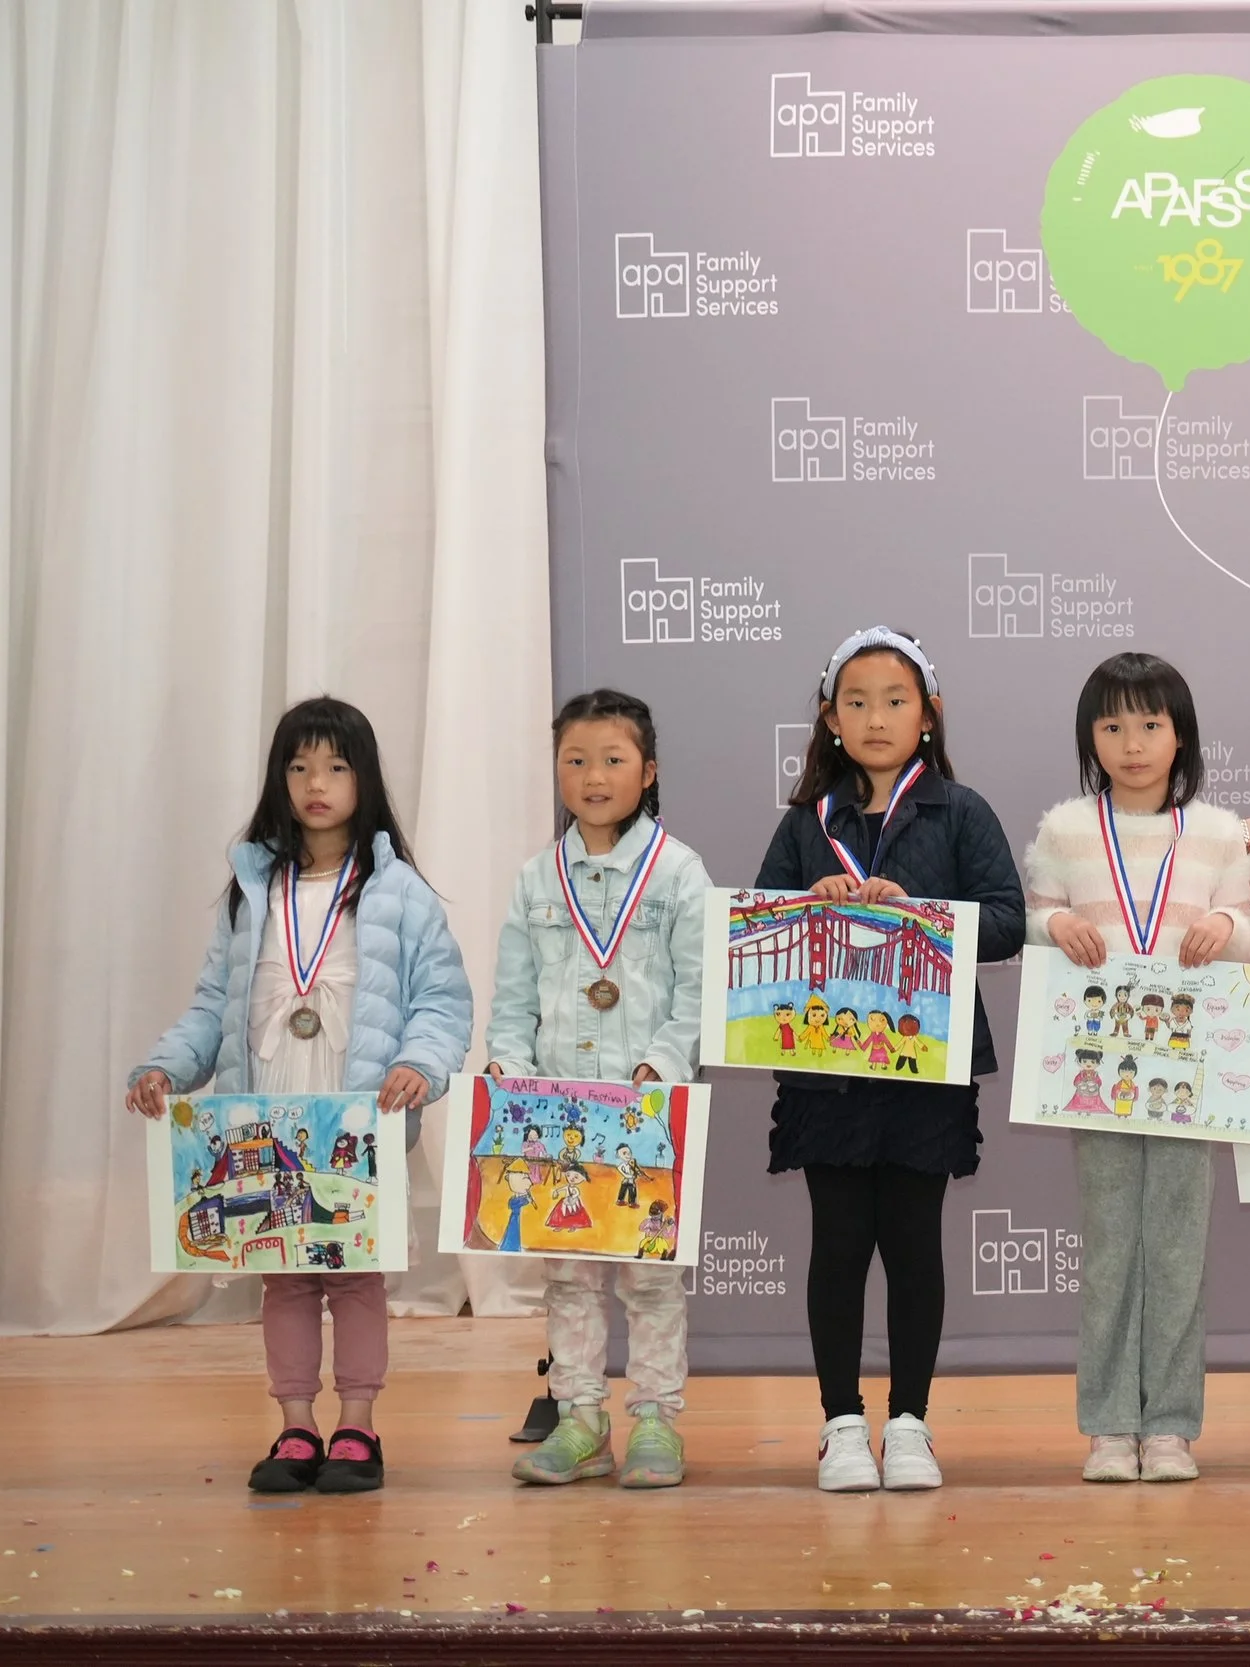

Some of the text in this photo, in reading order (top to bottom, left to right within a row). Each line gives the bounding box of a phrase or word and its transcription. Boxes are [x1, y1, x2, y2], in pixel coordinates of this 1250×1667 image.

[853, 92, 918, 118] Family
[778, 102, 840, 134] apa
[852, 114, 934, 139] Support
[852, 137, 935, 157] Services
[696, 251, 761, 277] Family
[974, 260, 1037, 289] apa
[1156, 238, 1244, 303] 1987
[622, 262, 684, 294] apa
[696, 273, 777, 298] Support
[696, 296, 778, 316] Services
[853, 417, 918, 443] Family
[1166, 415, 1233, 441] Family
[778, 427, 840, 459] apa
[853, 439, 934, 464] Support
[1090, 426, 1153, 456] apa
[1166, 437, 1249, 462] Support
[853, 462, 935, 481] Services
[1166, 460, 1250, 480] Services
[701, 576, 764, 602] Family
[1051, 573, 1117, 599] Family
[628, 588, 688, 620] apa
[701, 598, 780, 623] Support
[975, 584, 1038, 616] apa
[1051, 595, 1133, 620] Support
[701, 621, 782, 642] Services
[1051, 618, 1134, 638] Services
[1206, 764, 1250, 788] port
[511, 1079, 540, 1094] AAPI
[550, 1082, 578, 1097] Music
[704, 1230, 769, 1256] Family
[979, 1240, 1042, 1270] apa
[703, 1252, 785, 1277] Support
[703, 1275, 786, 1295] Services
